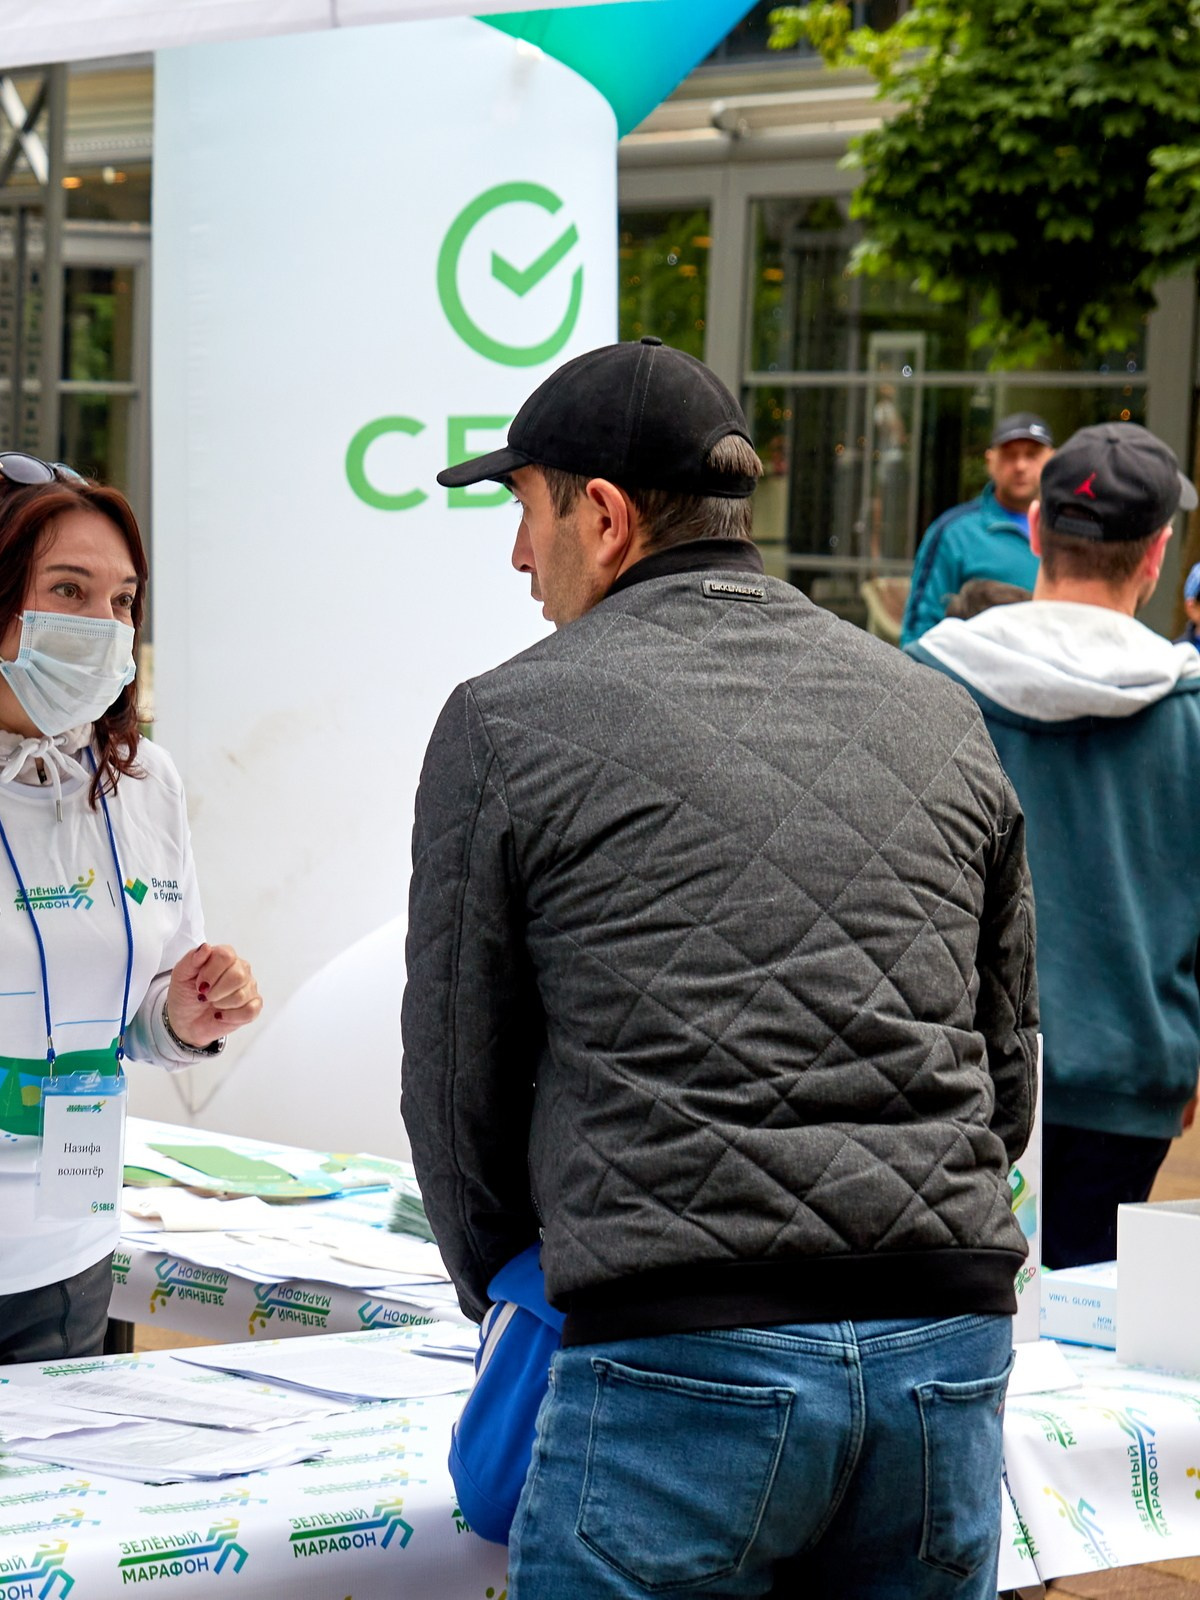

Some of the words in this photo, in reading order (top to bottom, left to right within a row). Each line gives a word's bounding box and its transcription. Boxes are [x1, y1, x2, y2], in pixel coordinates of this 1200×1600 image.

[151, 877, 178, 889] Вклад
[16, 900, 70, 911] МРАФОН
[153, 892, 159, 900] в
[64, 1142, 101, 1156] Назифа
[58, 1167, 104, 1178] волонтёр
[99, 1202, 115, 1211] SBER
[178, 1265, 229, 1286] МАРАФОН
[177, 1286, 225, 1306] ЗЕЛЁНЫЙ
[277, 1286, 332, 1307] МАРАФОН
[1049, 1293, 1068, 1303] VINYL
[1072, 1297, 1101, 1308] GLOVES
[277, 1307, 328, 1328] ЗЕЛЁНЫЙ
[1097, 1316, 1112, 1324] NON
[1127, 1444, 1154, 1532] ЗЕЛЁНЫЙ
[1146, 1442, 1172, 1536] МАРАФОН
[289, 1508, 369, 1530] ЗЕЛЁНЫЙ
[119, 1530, 203, 1555] ЗЕЛЁНЫЙ
[293, 1532, 377, 1558] МАРАФОН
[121, 1556, 209, 1584] МАРАФОН
